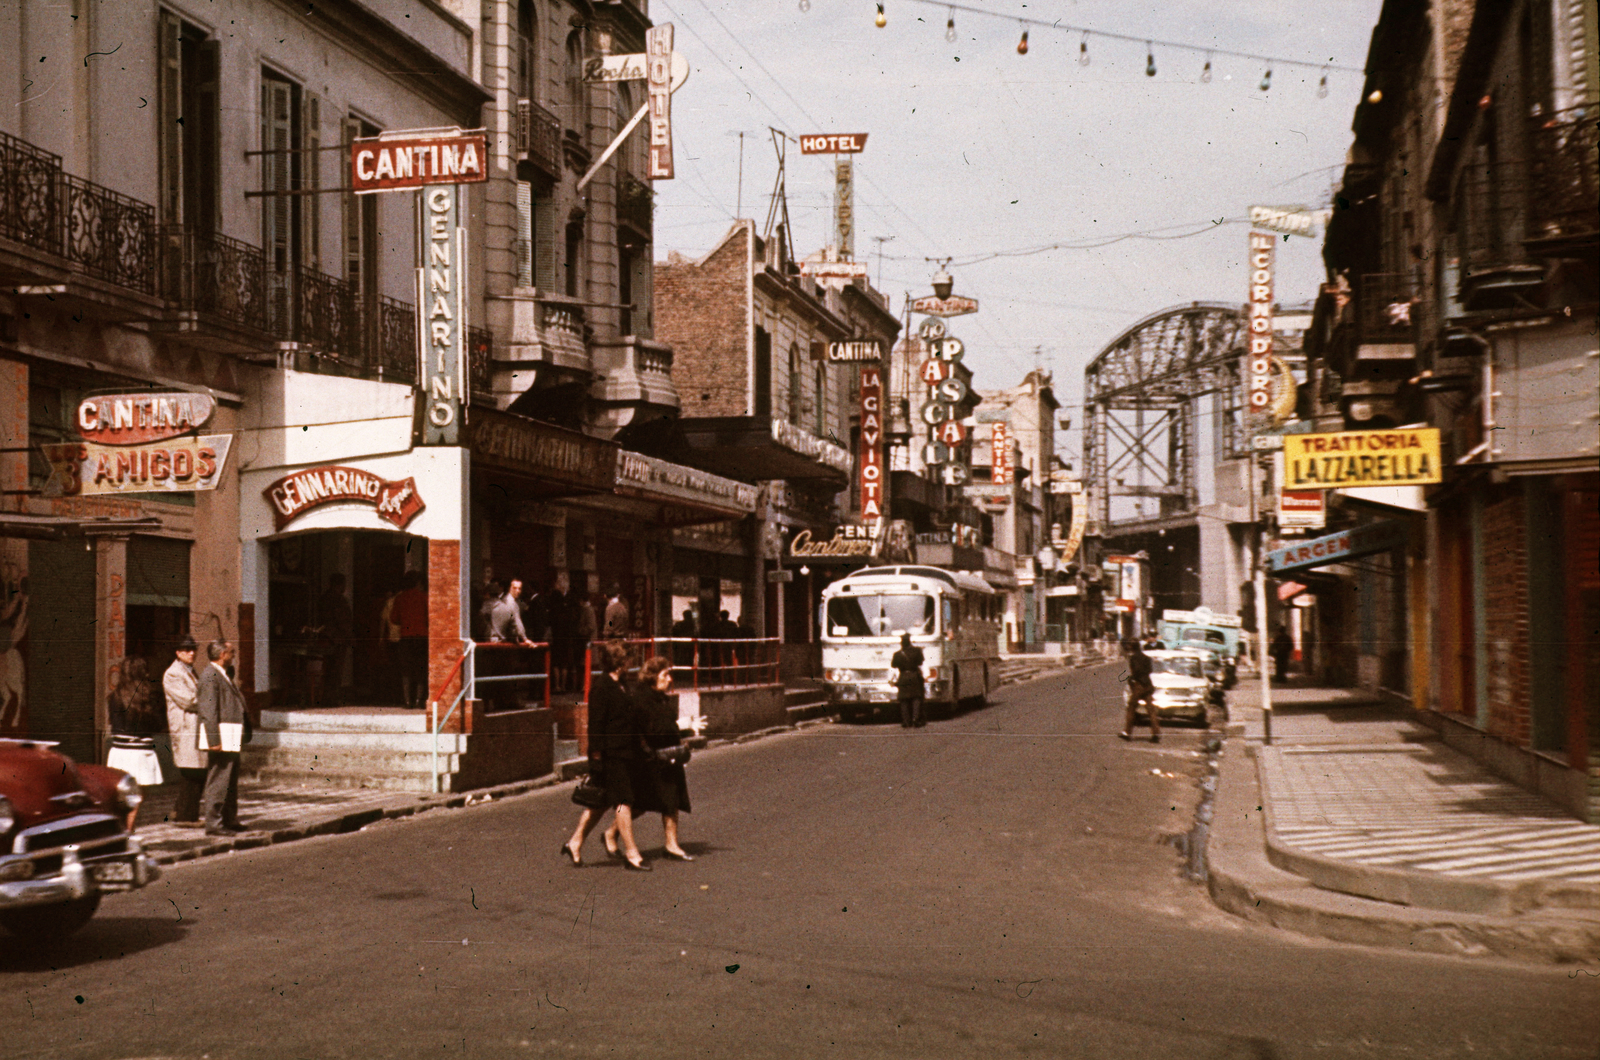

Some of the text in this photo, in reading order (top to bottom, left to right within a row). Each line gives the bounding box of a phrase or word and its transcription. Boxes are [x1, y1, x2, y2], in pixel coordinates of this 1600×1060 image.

[650, 29, 669, 176] HOTEL
[356, 143, 481, 181] CANTINA
[803, 137, 860, 150] HOTEL
[428, 189, 453, 427] GENNARINO
[915, 301, 974, 311] CANTINA
[829, 342, 881, 360] CANTINA
[78, 398, 195, 431] CANTINA
[863, 373, 881, 515] LA GAVIOTA
[993, 423, 1004, 484] CANTINA
[1302, 434, 1422, 453] TRATTORIA
[95, 447, 217, 485] AMIGOS
[1294, 453, 1432, 484] LAZZARELLA
[272, 470, 380, 515] GENNARINO
